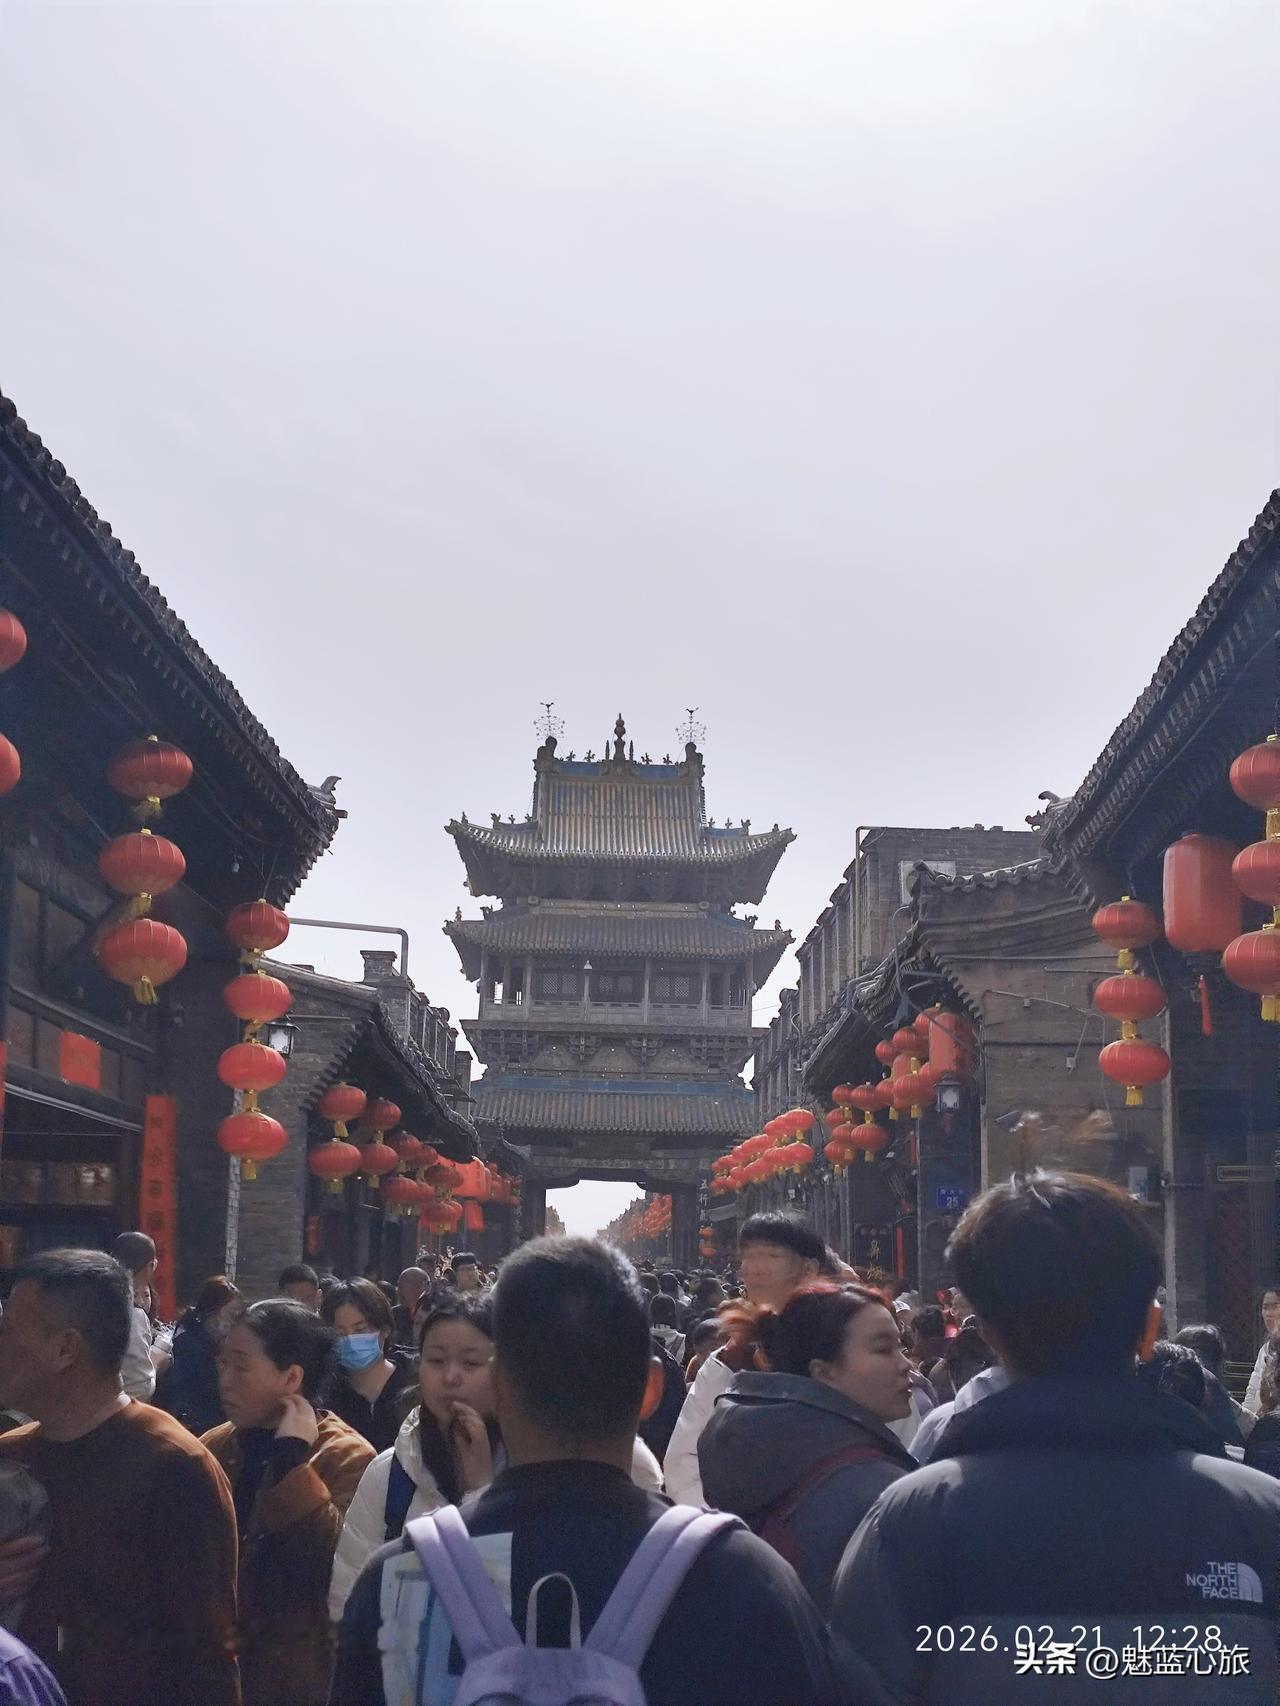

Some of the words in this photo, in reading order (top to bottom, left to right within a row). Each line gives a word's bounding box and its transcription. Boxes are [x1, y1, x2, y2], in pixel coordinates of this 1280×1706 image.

[1207, 1561, 1237, 1575] THE
[1186, 1573, 1238, 1587] NORTH
[1202, 1586, 1239, 1599] FACE
